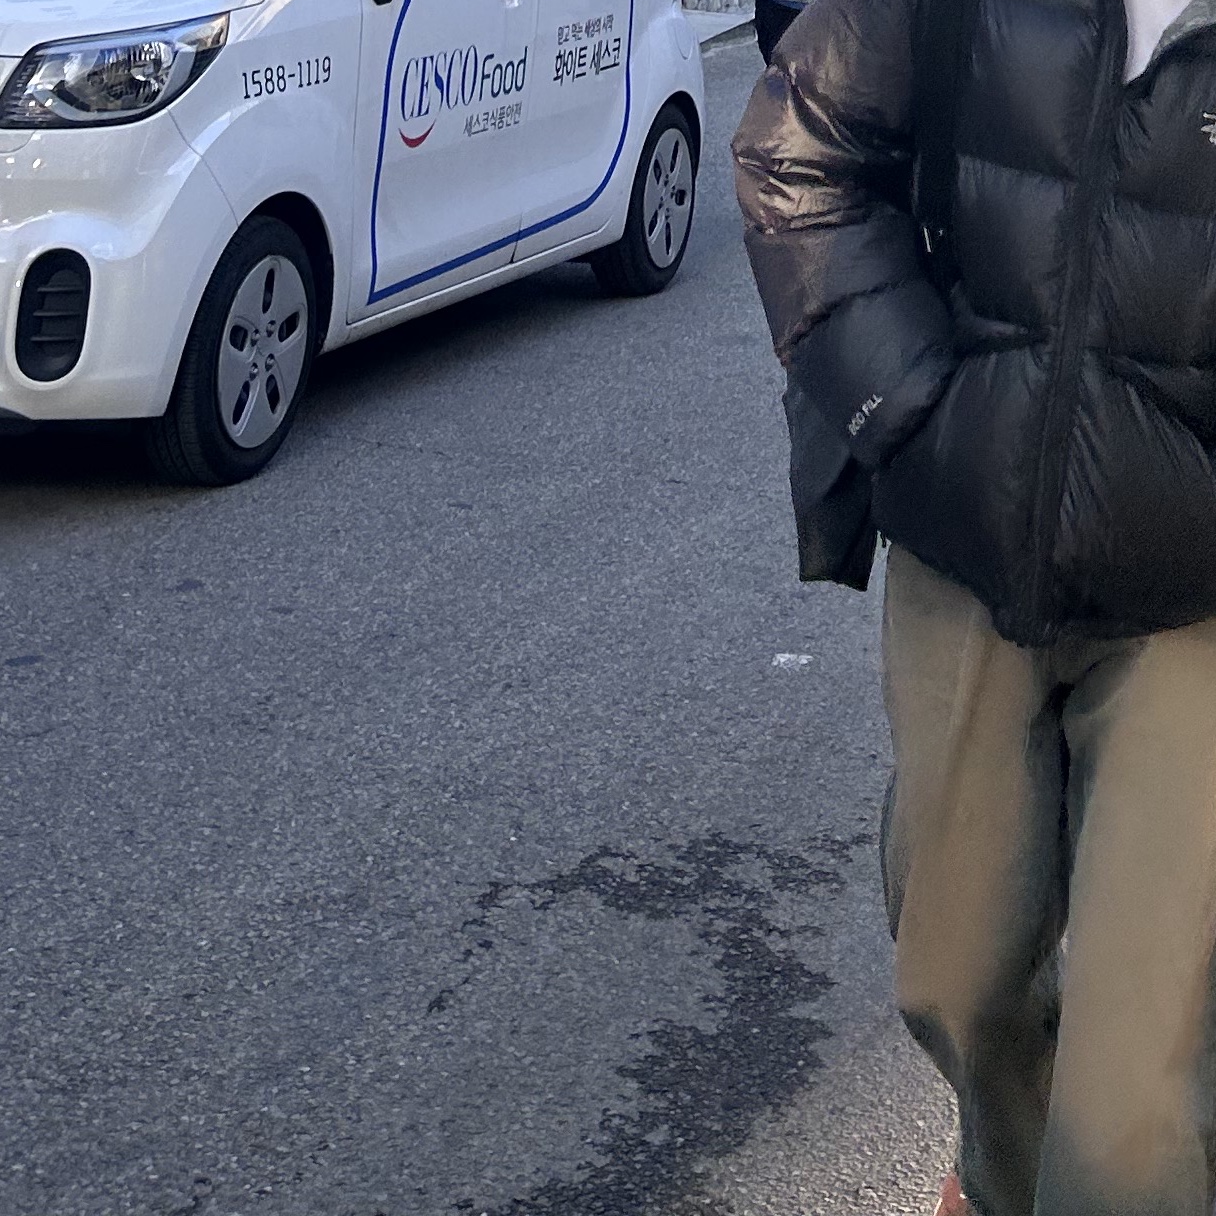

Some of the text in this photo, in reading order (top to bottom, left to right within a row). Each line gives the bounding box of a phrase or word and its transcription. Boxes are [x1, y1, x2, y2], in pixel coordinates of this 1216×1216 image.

[241, 56, 332, 99] 1588-1119
[478, 46, 529, 102] Food
[553, 37, 621, 86] 화이트 세스코
[862, 394, 883, 416] FILL
